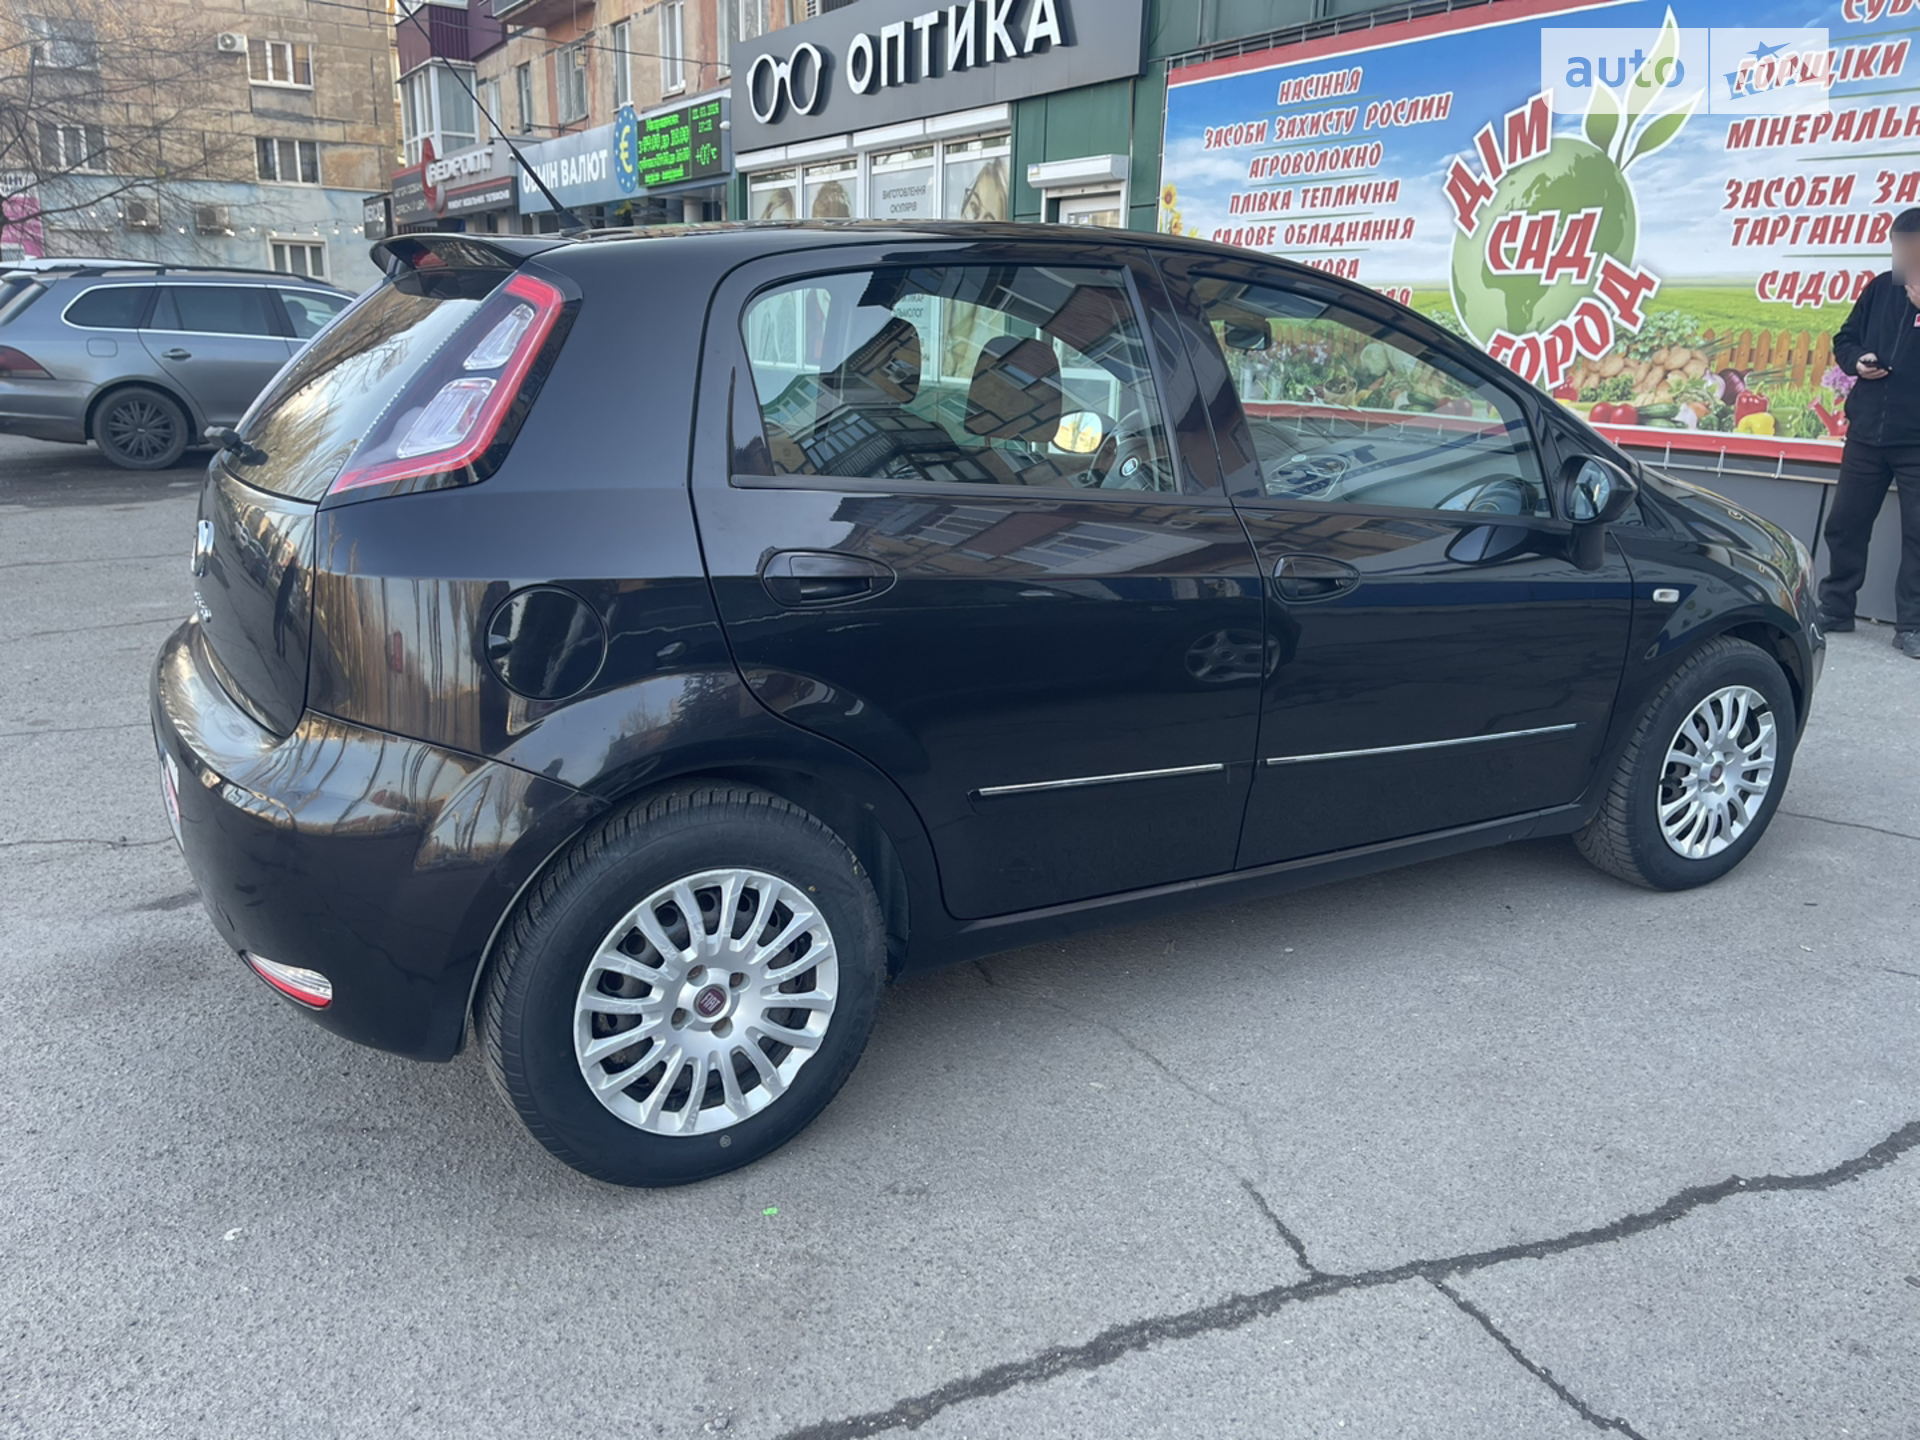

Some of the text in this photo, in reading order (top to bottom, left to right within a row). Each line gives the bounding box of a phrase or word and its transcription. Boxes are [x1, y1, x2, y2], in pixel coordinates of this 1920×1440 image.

[1844, 0, 1920, 20] СУ
[846, 0, 1062, 95] ОПТИКА
[1279, 68, 1361, 103] НАСІННЯ
[1204, 94, 1451, 149] ЗАСОБИ ЗАХИСТУ РОСЛИН
[1726, 106, 1920, 149] МІНЕРАЛЬН
[562, 149, 608, 187] ВАЛЮТ
[1249, 143, 1382, 178] АГРОВОЛОКНО
[1446, 95, 1550, 232] ДІМ
[1229, 180, 1400, 214] ПЛІВКА ТЕПЛИЧНА
[1723, 170, 1920, 210] ЗАСОБИ ЗА
[1213, 218, 1415, 248] САДОВЕ ОБЛАДНАННЯ
[1488, 212, 1600, 281] САД
[1732, 212, 1893, 246] ТАРГАНІВ
[700, 992, 721, 1012] FIAT
